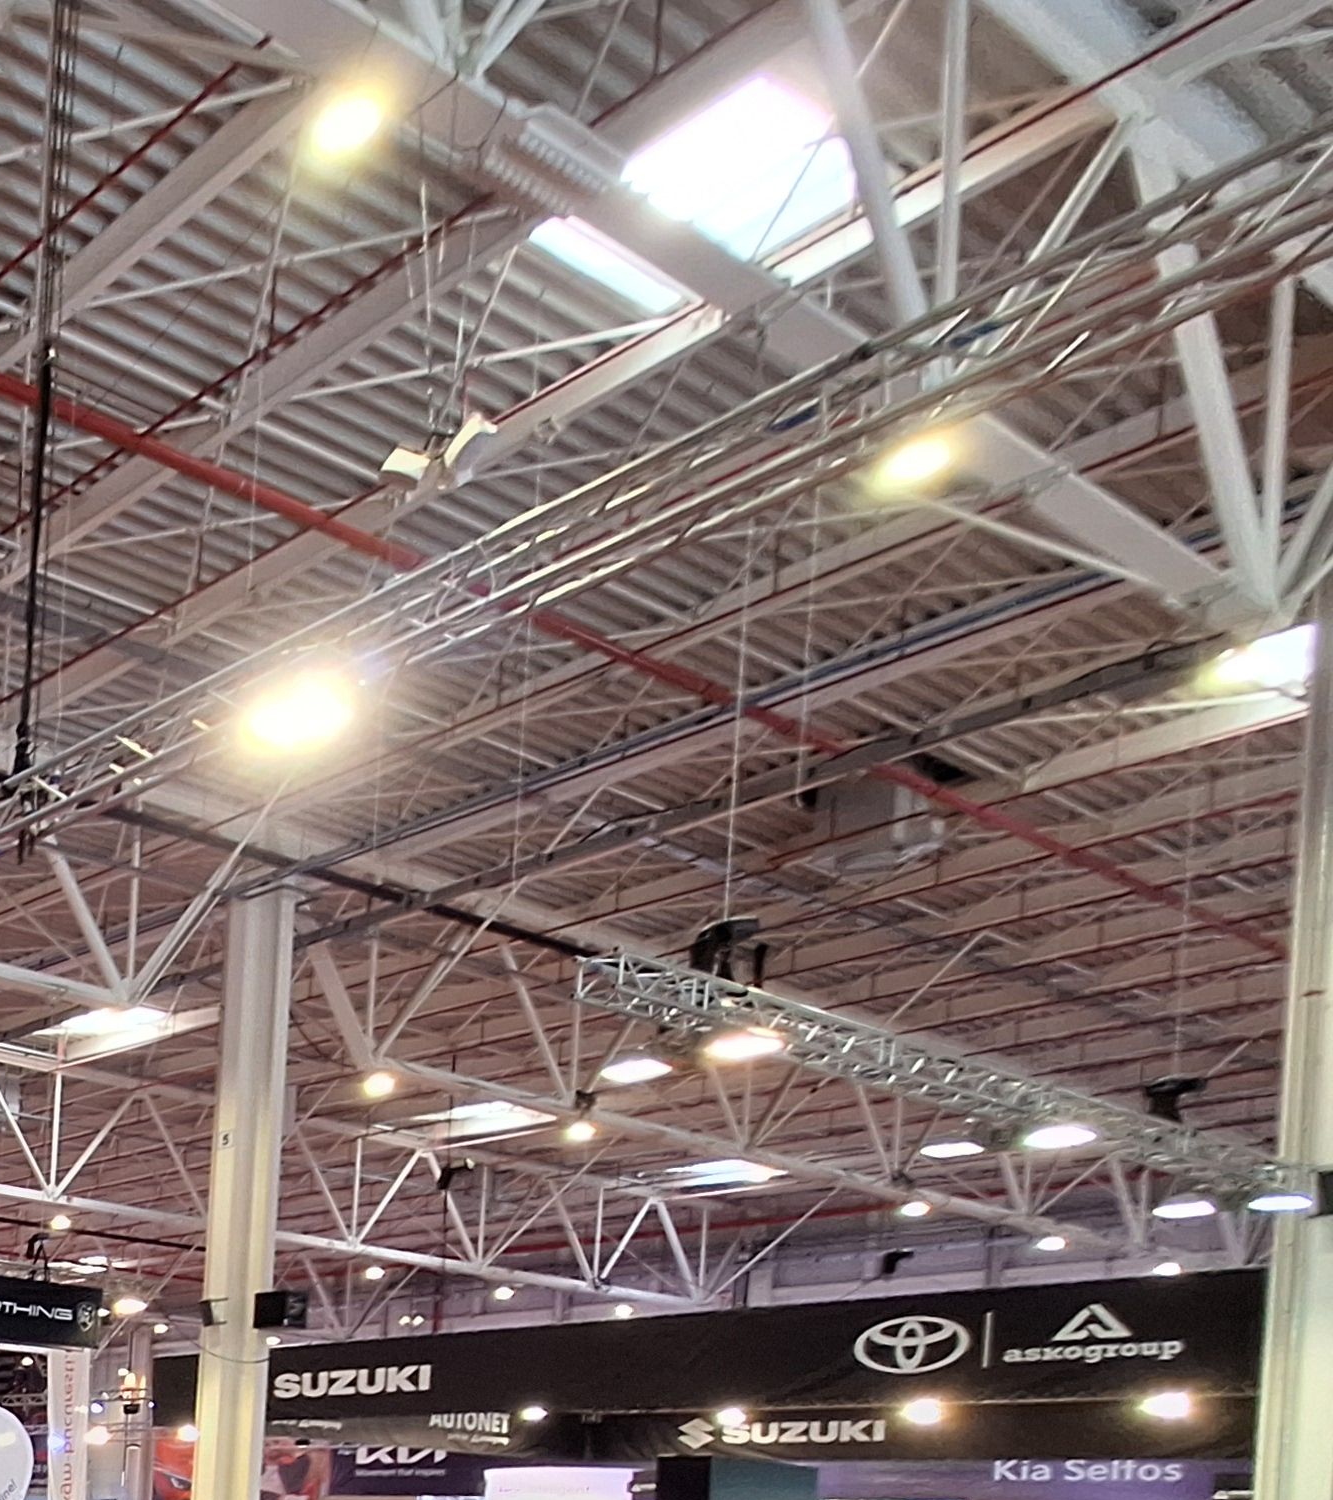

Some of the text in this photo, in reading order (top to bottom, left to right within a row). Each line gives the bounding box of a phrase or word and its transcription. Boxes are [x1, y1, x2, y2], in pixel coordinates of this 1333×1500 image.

[1002, 1338, 1183, 1363] askogroup
[273, 1364, 432, 1399] SUZUKI
[428, 1412, 511, 1434] AUTONET
[721, 1419, 886, 1446] SUZUKI
[993, 1459, 1183, 1482] Kia Seltos
